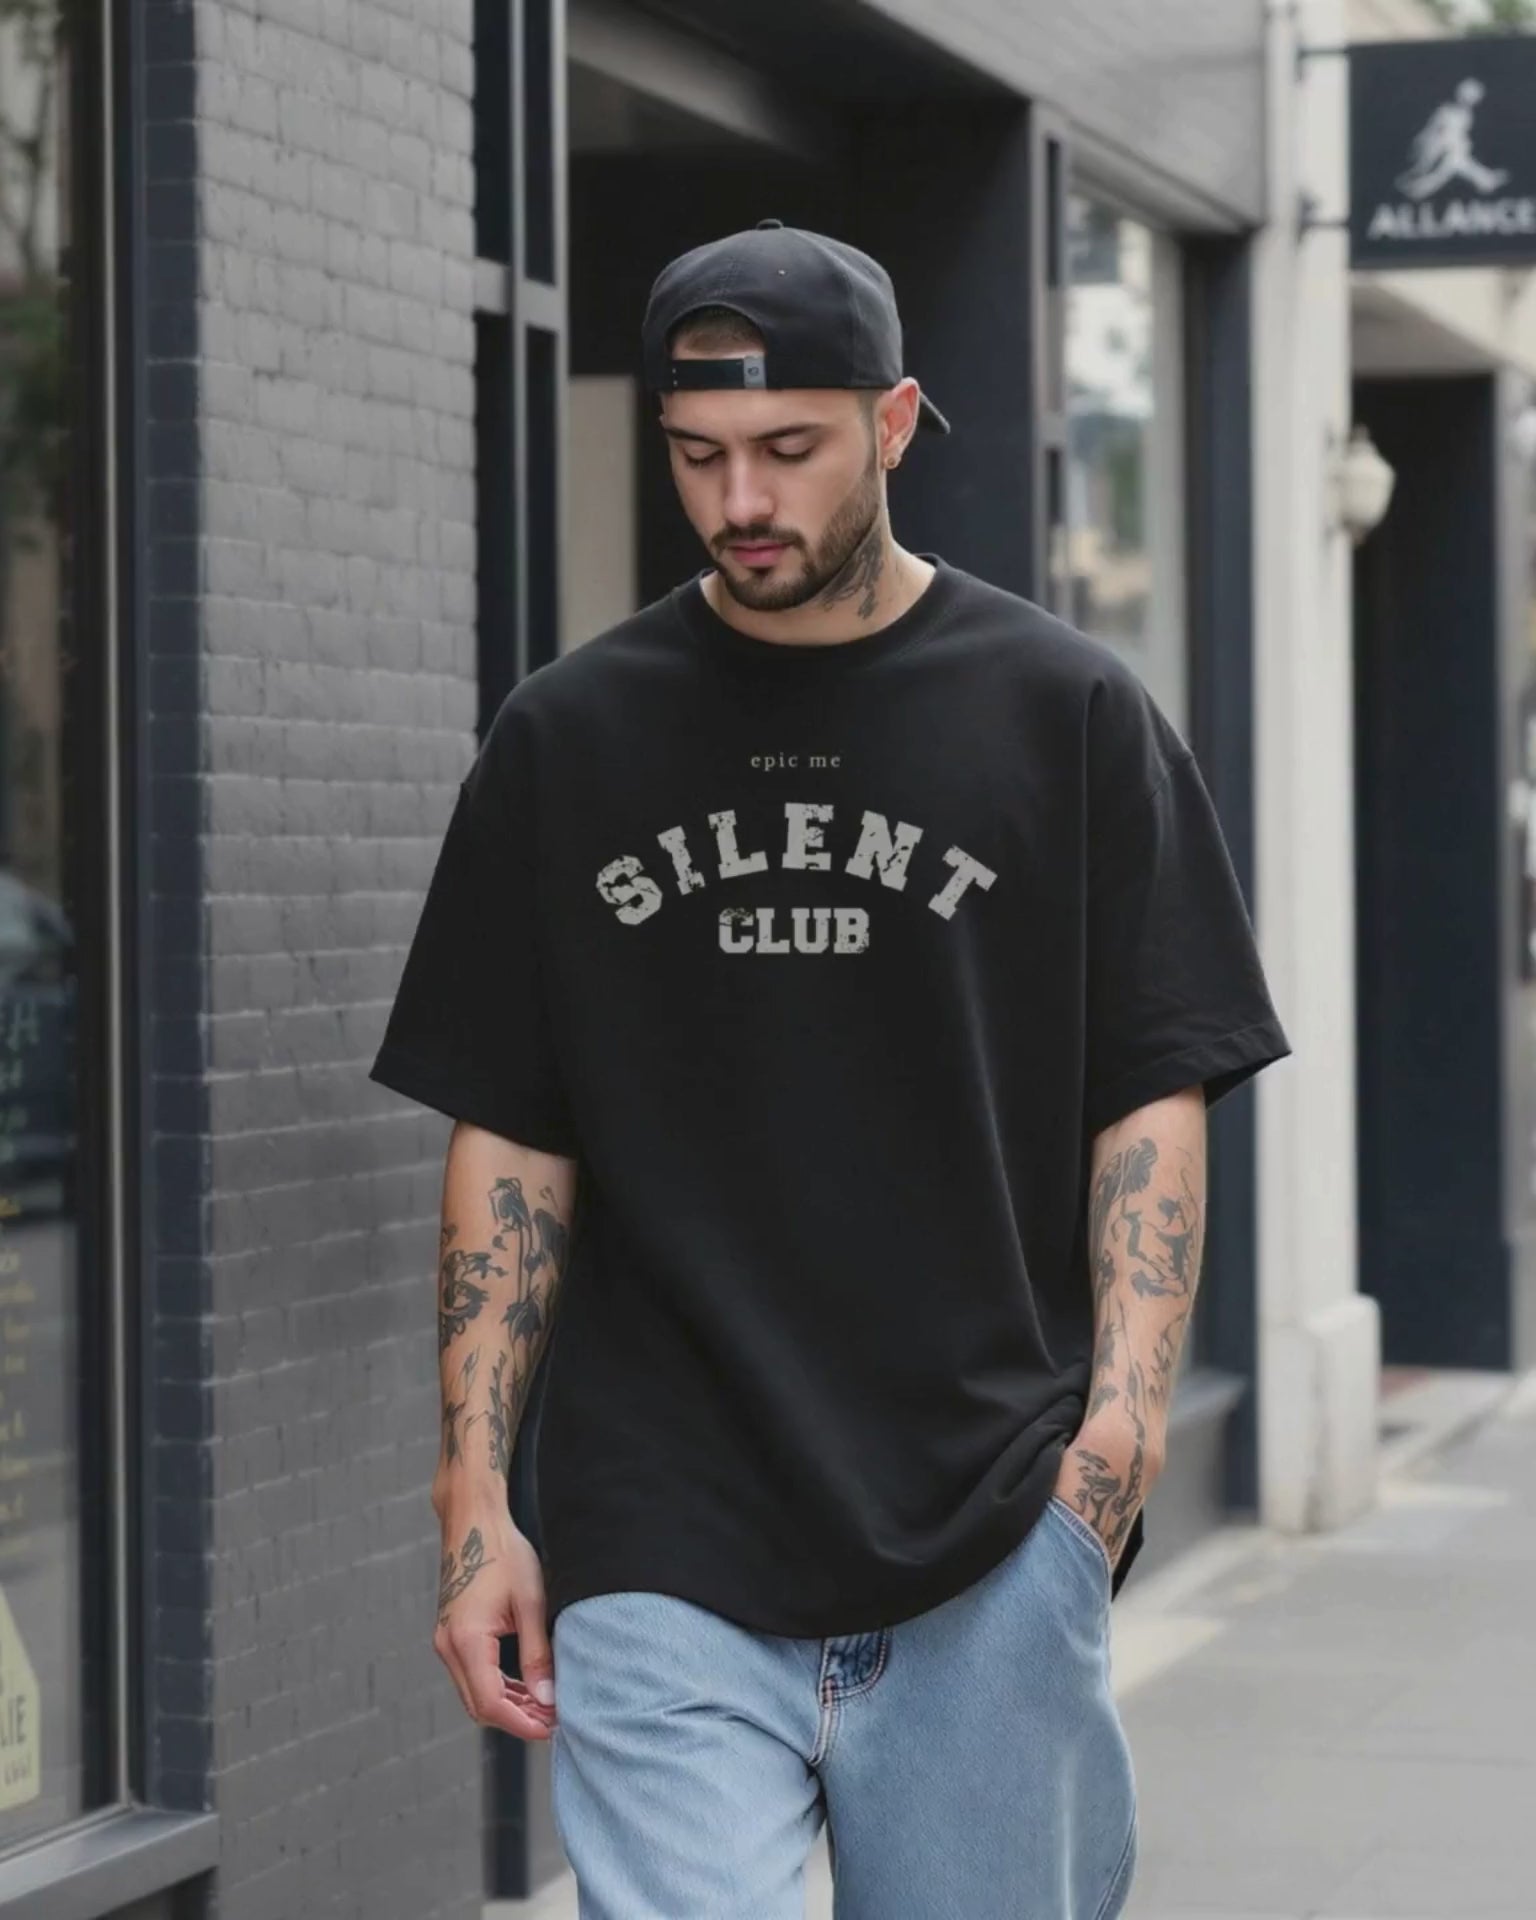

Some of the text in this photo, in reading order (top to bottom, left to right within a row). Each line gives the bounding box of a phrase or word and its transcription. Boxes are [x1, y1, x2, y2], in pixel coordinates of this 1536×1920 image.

[750, 753, 841, 772] epic me
[595, 802, 998, 926] SILENT
[718, 907, 870, 954] CLUB
